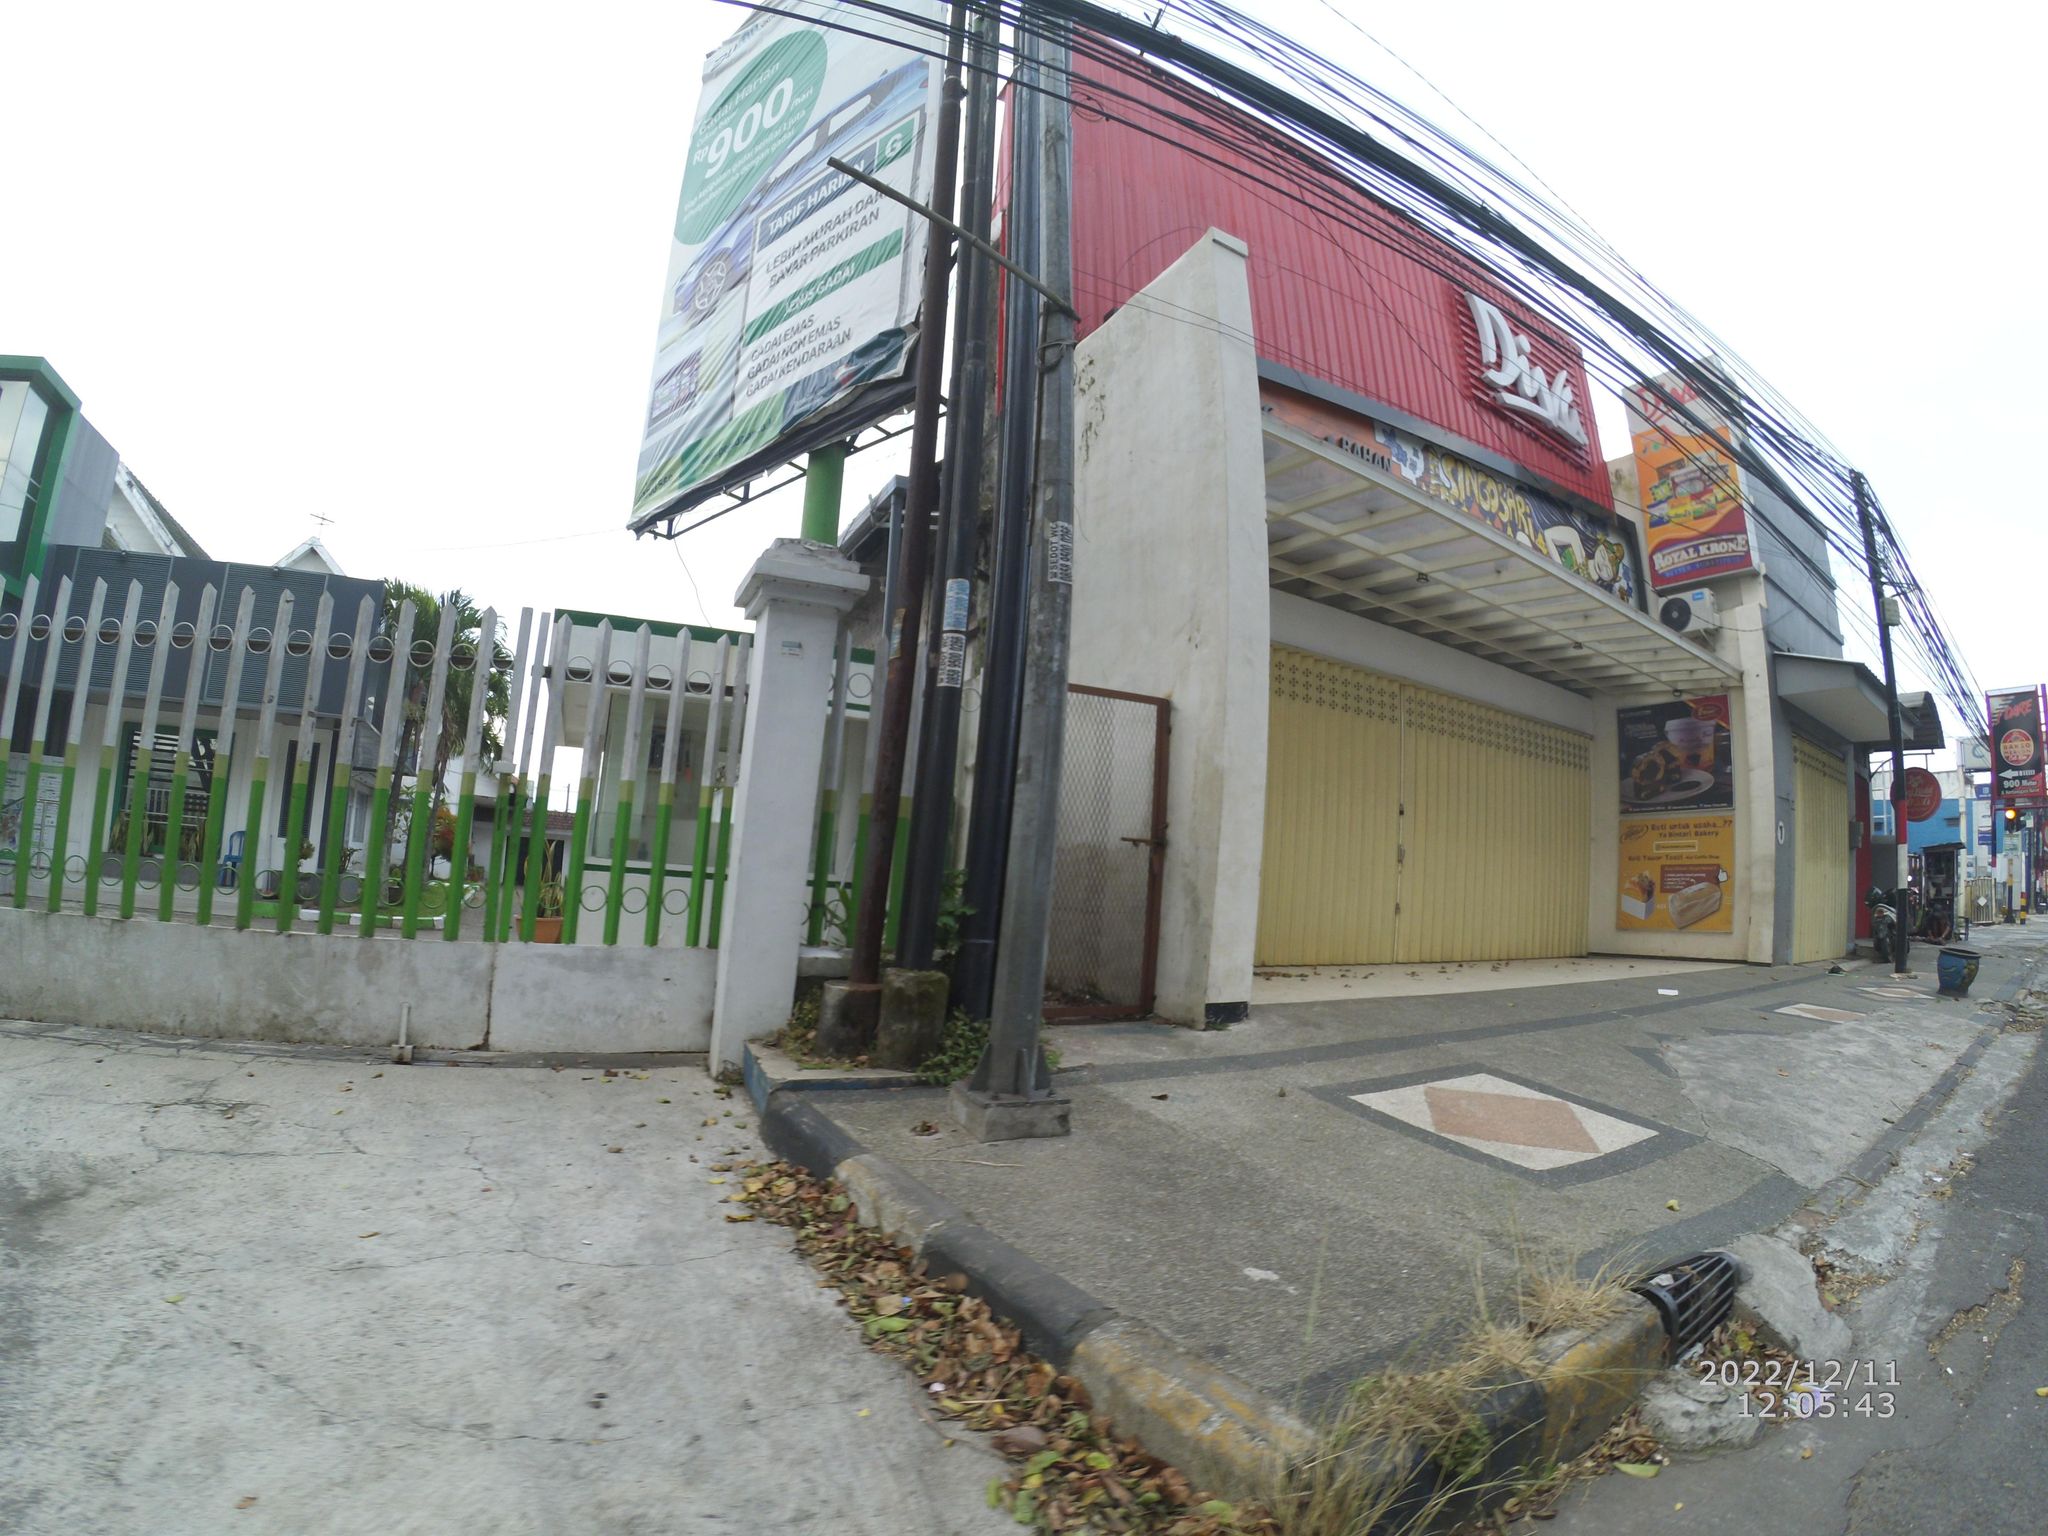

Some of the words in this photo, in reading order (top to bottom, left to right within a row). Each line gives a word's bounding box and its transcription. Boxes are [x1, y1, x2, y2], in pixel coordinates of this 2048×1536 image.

[705, 77, 794, 179] 900
[768, 200, 806, 235] TARIF
[810, 206, 880, 262] PARKIRAN
[745, 369, 779, 398] GADAI
[778, 327, 852, 379] KENDARAAN
[747, 352, 780, 380] GADAI
[808, 315, 841, 345] EMAS
[751, 333, 782, 362] GADAI
[783, 314, 815, 341] EMAS
[1653, 547, 1698, 572] ROYAL
[1698, 534, 1748, 556] KRONE
